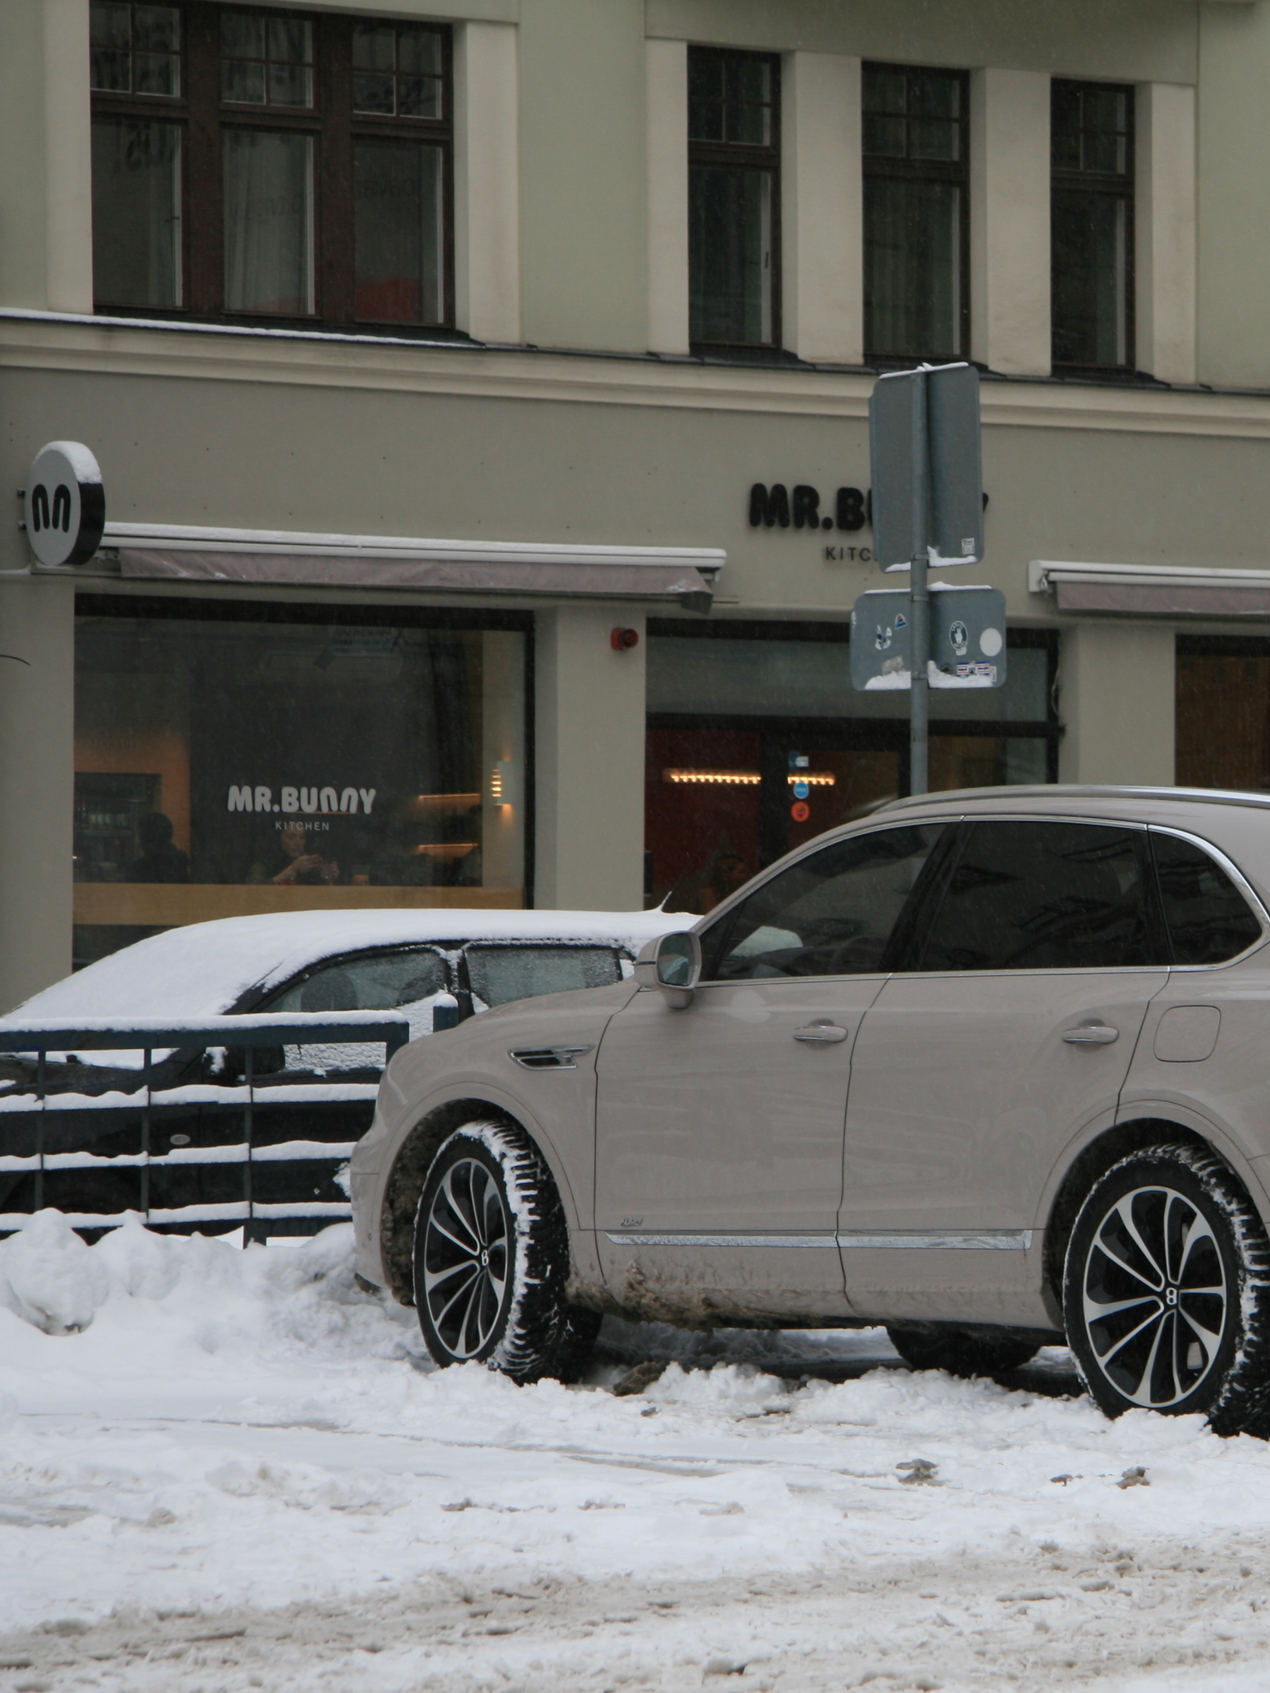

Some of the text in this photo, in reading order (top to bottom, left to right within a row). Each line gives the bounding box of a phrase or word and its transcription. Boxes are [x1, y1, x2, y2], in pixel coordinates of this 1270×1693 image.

[826, 547, 877, 561] KITC
[227, 785, 377, 814] MR.BUNNY
[275, 821, 330, 831] KITCHEN
